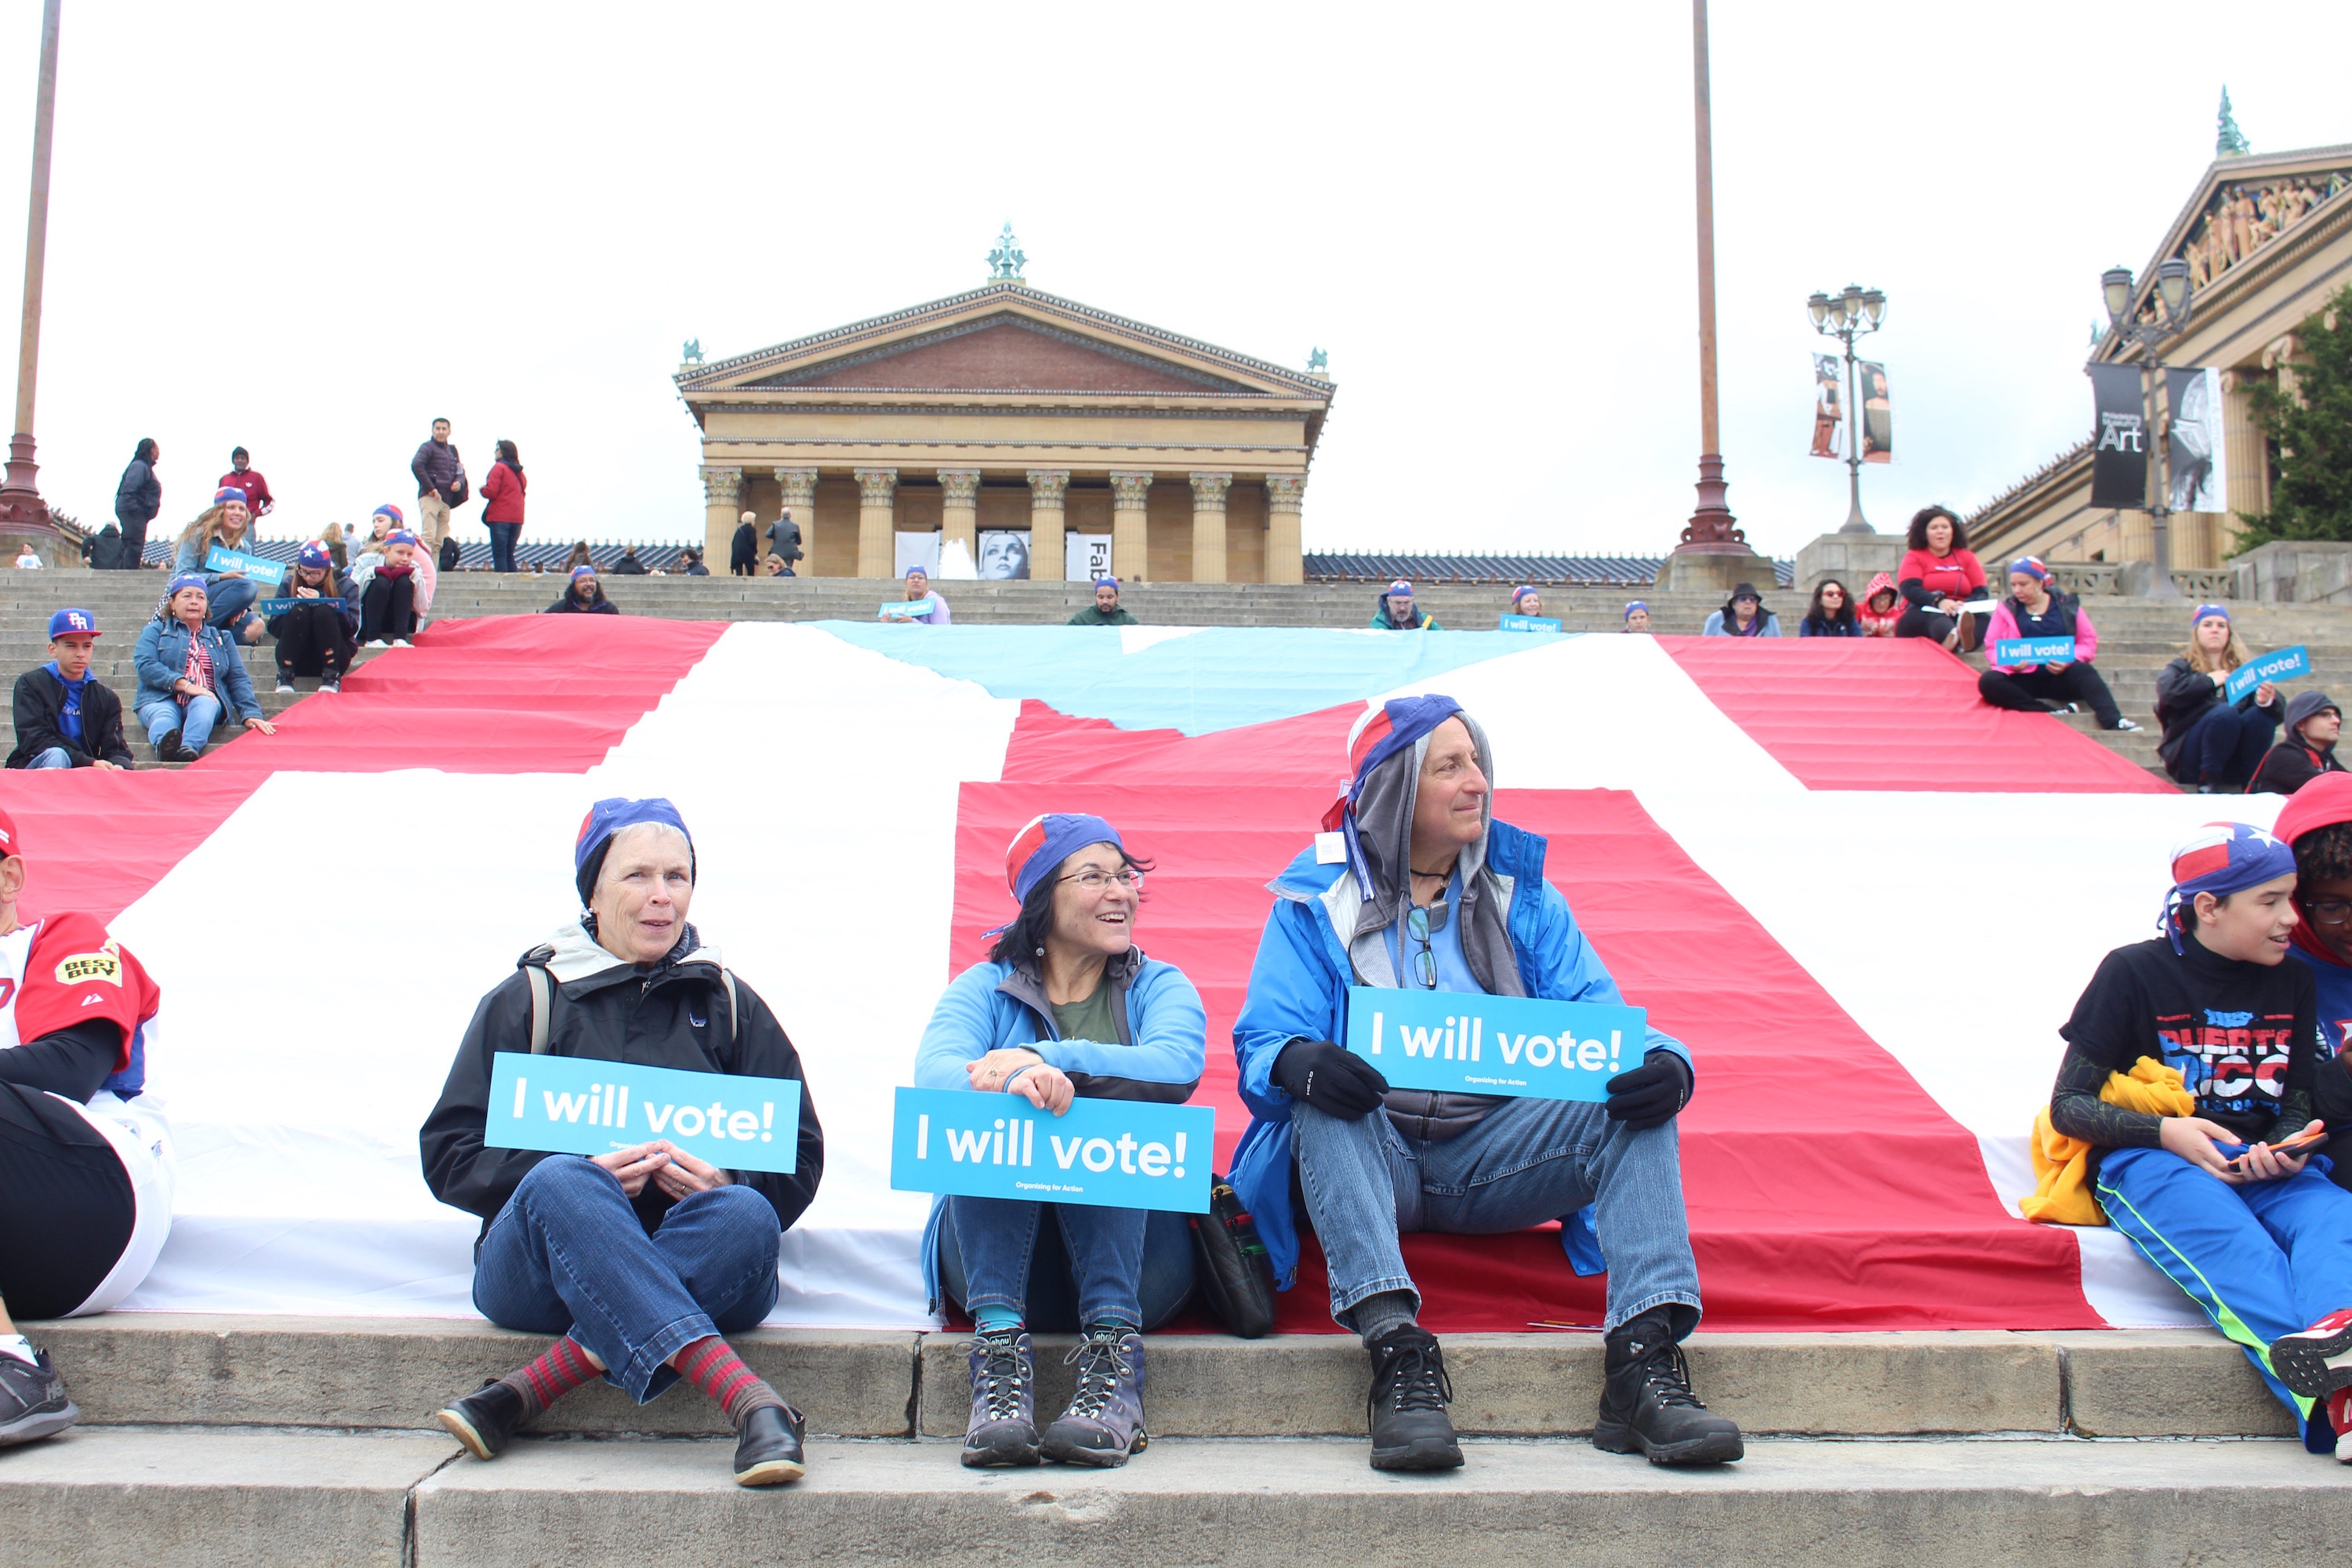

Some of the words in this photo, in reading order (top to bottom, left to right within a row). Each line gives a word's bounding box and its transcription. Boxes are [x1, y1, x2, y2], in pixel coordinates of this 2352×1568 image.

[2098, 424, 2143, 452] Art
[212, 552, 219, 563] I
[220, 556, 243, 569] will
[245, 561, 278, 578] vote!
[1504, 619, 1508, 628] I
[1510, 619, 1528, 630] will
[1530, 623, 1556, 633] vote!
[2001, 645, 2005, 658] I
[2008, 644, 2032, 657] will
[2034, 642, 2070, 656] vote!
[2230, 681, 2236, 695] I
[2235, 667, 2256, 690] will
[2257, 653, 2301, 677] vote!
[65, 960, 117, 971] BEST
[68, 967, 114, 979] BUY
[1372, 1012, 1383, 1054] I
[1399, 1015, 1482, 1062] will
[1497, 1029, 1621, 1073] vote!
[1465, 1075, 1497, 1085] Organizing
[513, 1077, 527, 1118] I
[543, 1083, 629, 1128] will
[644, 1102, 774, 1142] vote!
[917, 1114, 929, 1160] I
[946, 1118, 1033, 1167] will
[1050, 1132, 1187, 1178] vote!
[1015, 1181, 1051, 1192] Organizing
